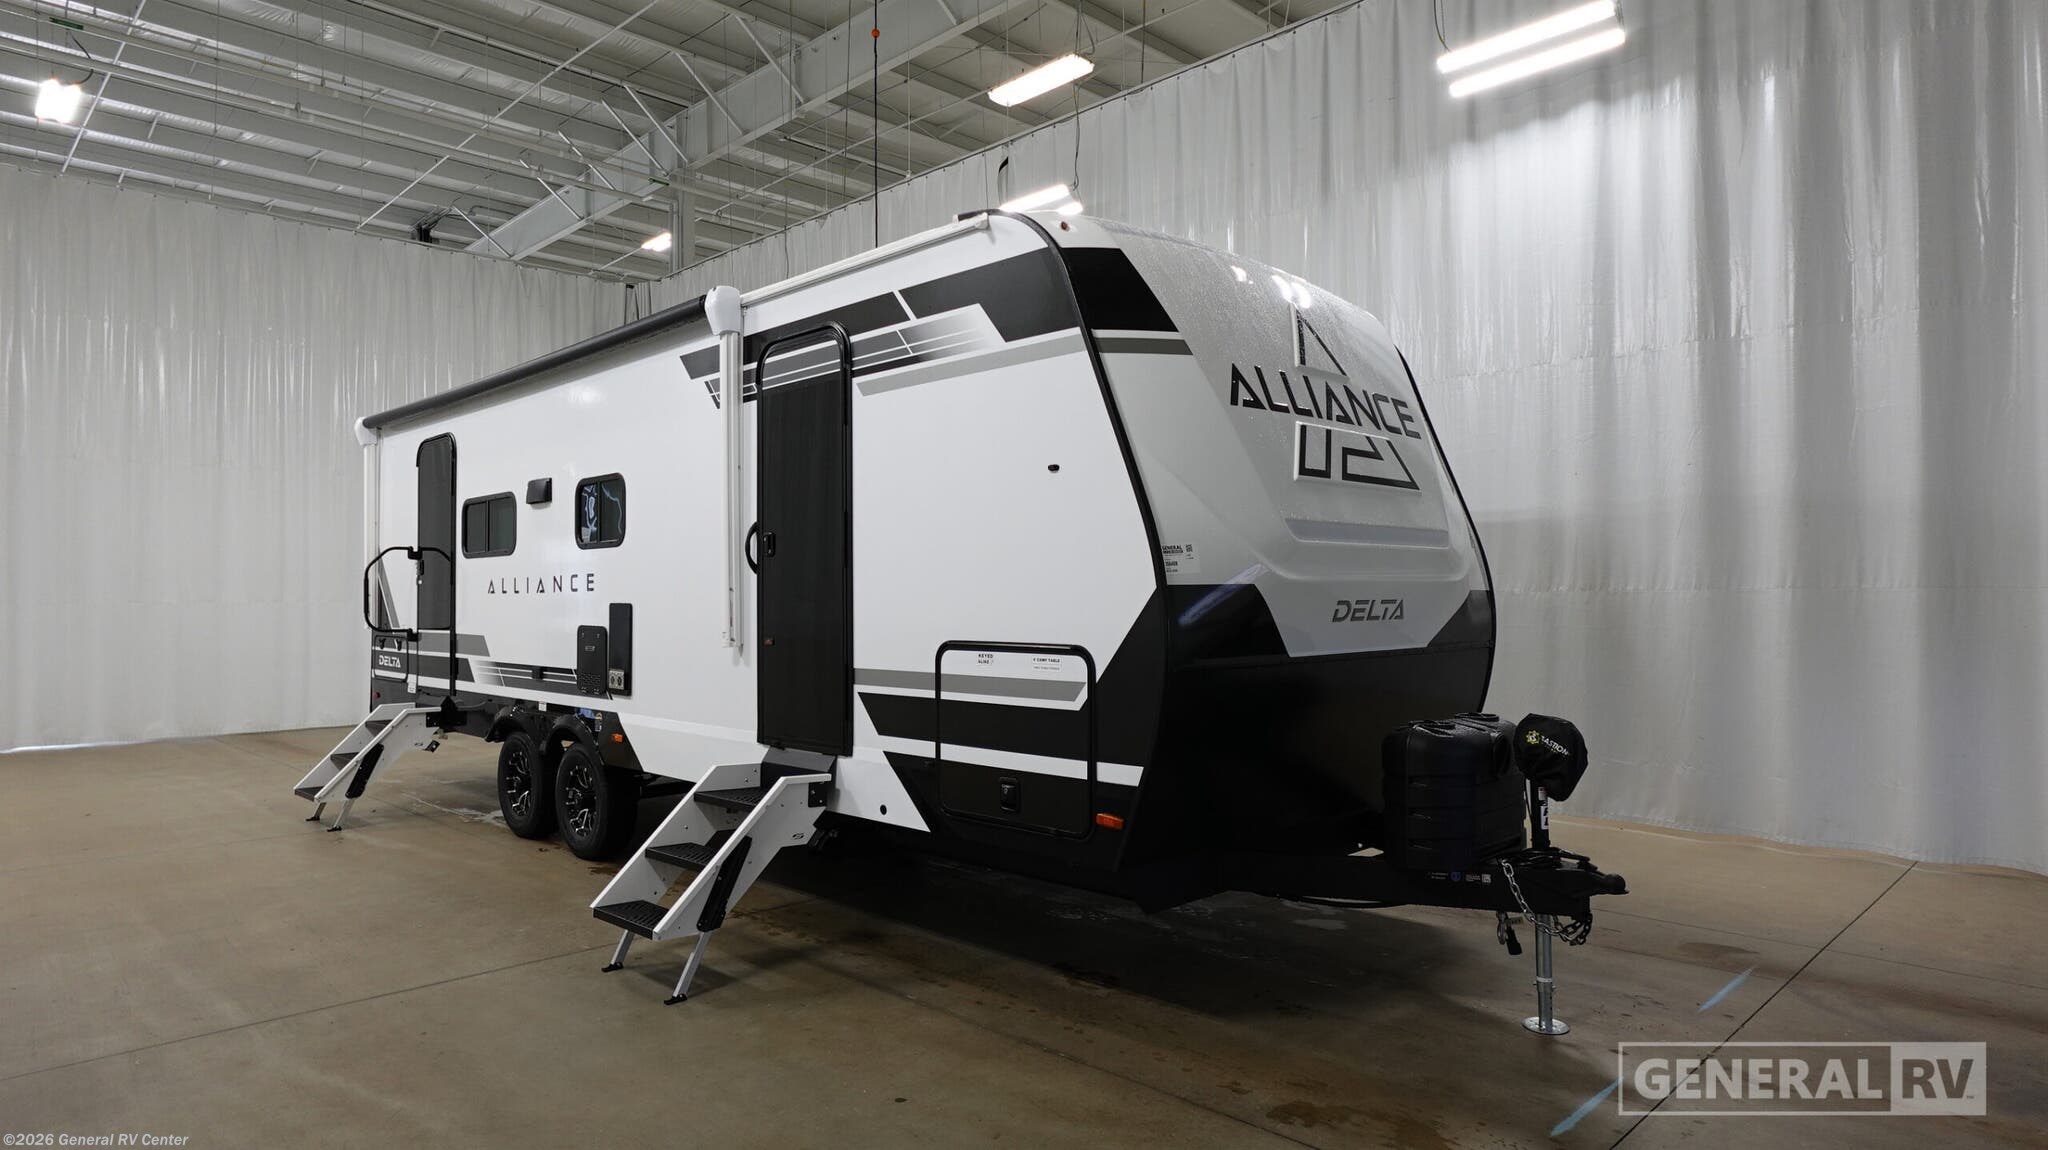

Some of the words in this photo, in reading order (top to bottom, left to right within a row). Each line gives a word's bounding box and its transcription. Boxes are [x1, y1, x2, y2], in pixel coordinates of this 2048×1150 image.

[1230, 363, 1421, 439] ALLIANCE
[488, 573, 594, 593] ALLIANCE
[1332, 599, 1404, 622] DELTA
[378, 655, 401, 668] DELTA
